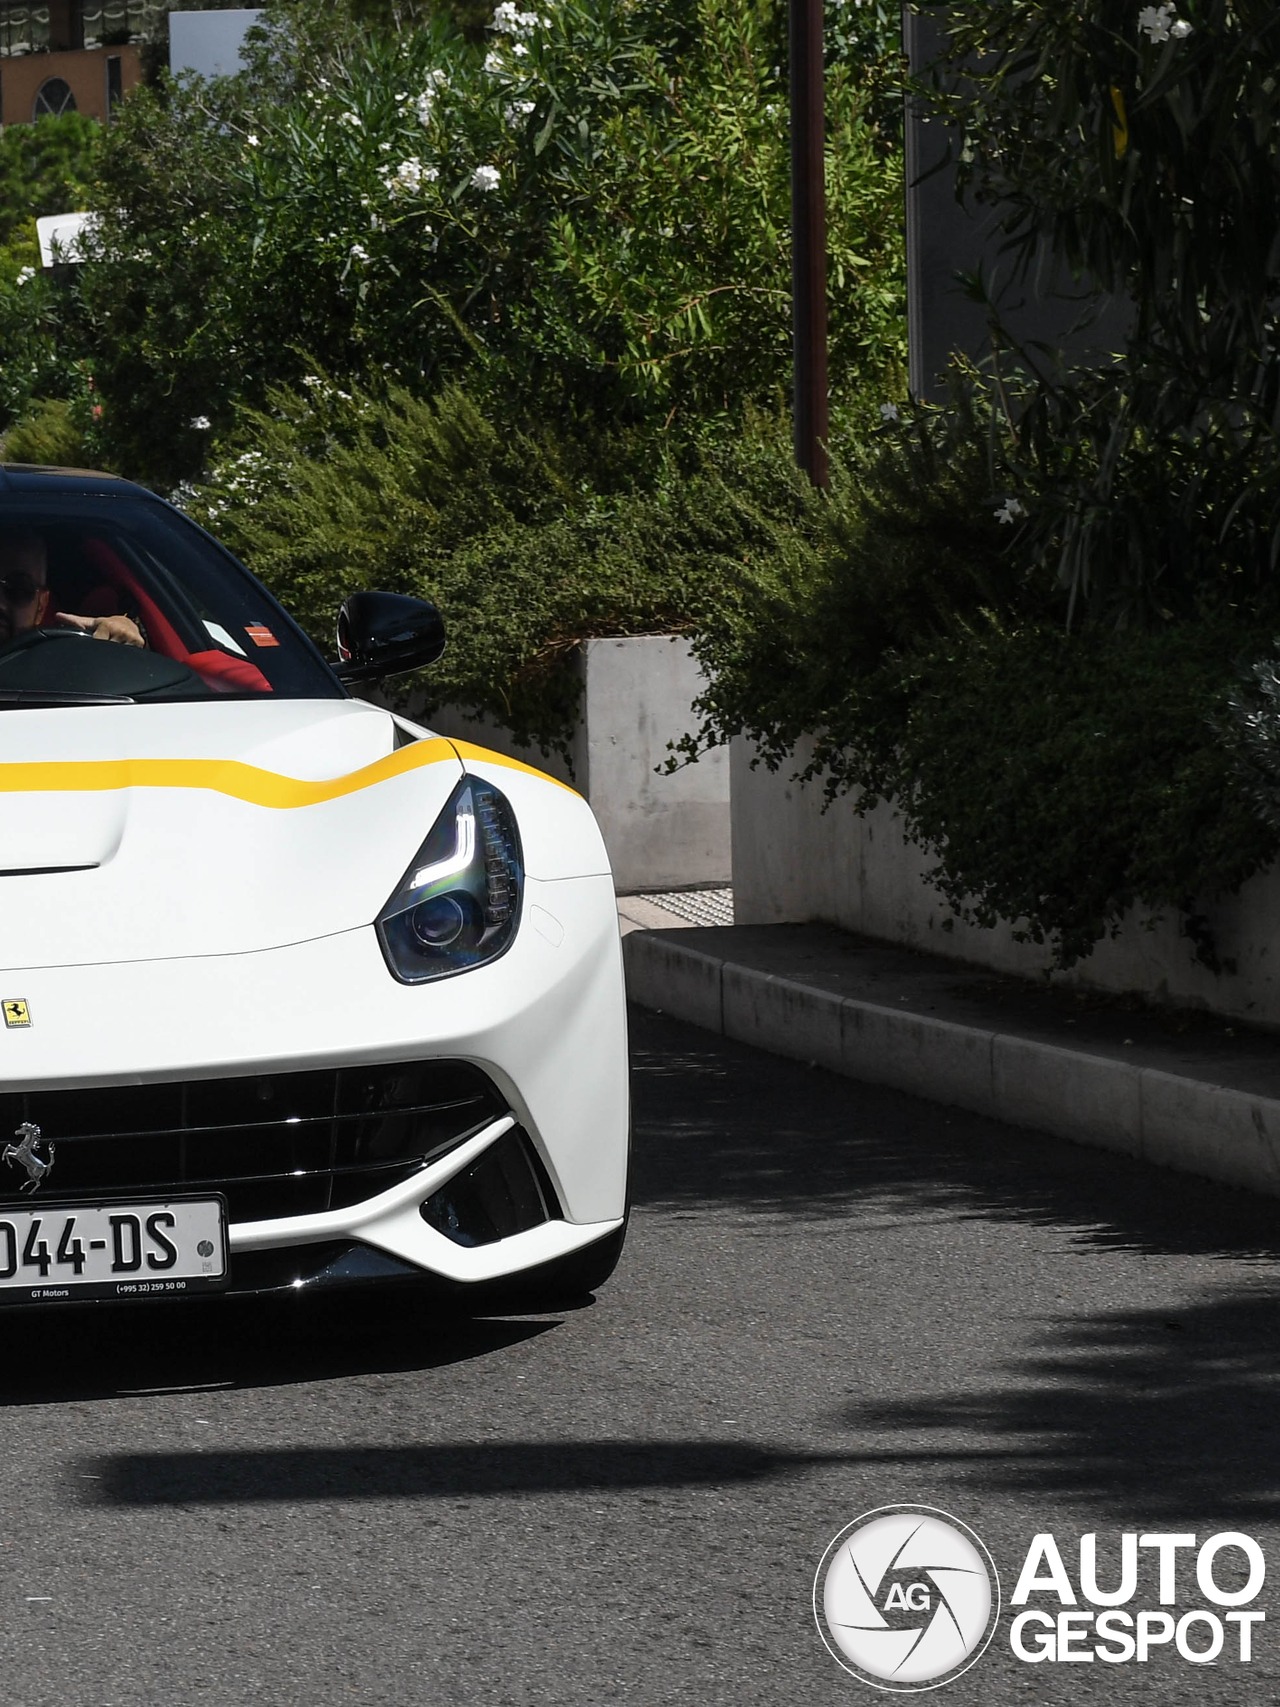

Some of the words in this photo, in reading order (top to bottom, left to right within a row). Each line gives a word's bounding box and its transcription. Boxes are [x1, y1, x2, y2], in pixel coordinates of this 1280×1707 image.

[116, 1283, 137, 1294] (+995
[138, 1283, 150, 1292] 32)
[151, 1283, 164, 1291] 259
[165, 1282, 175, 1290] 50
[176, 1281, 186, 1289] 00
[31, 1290, 41, 1298] GT
[42, 1289, 69, 1298] Motors
